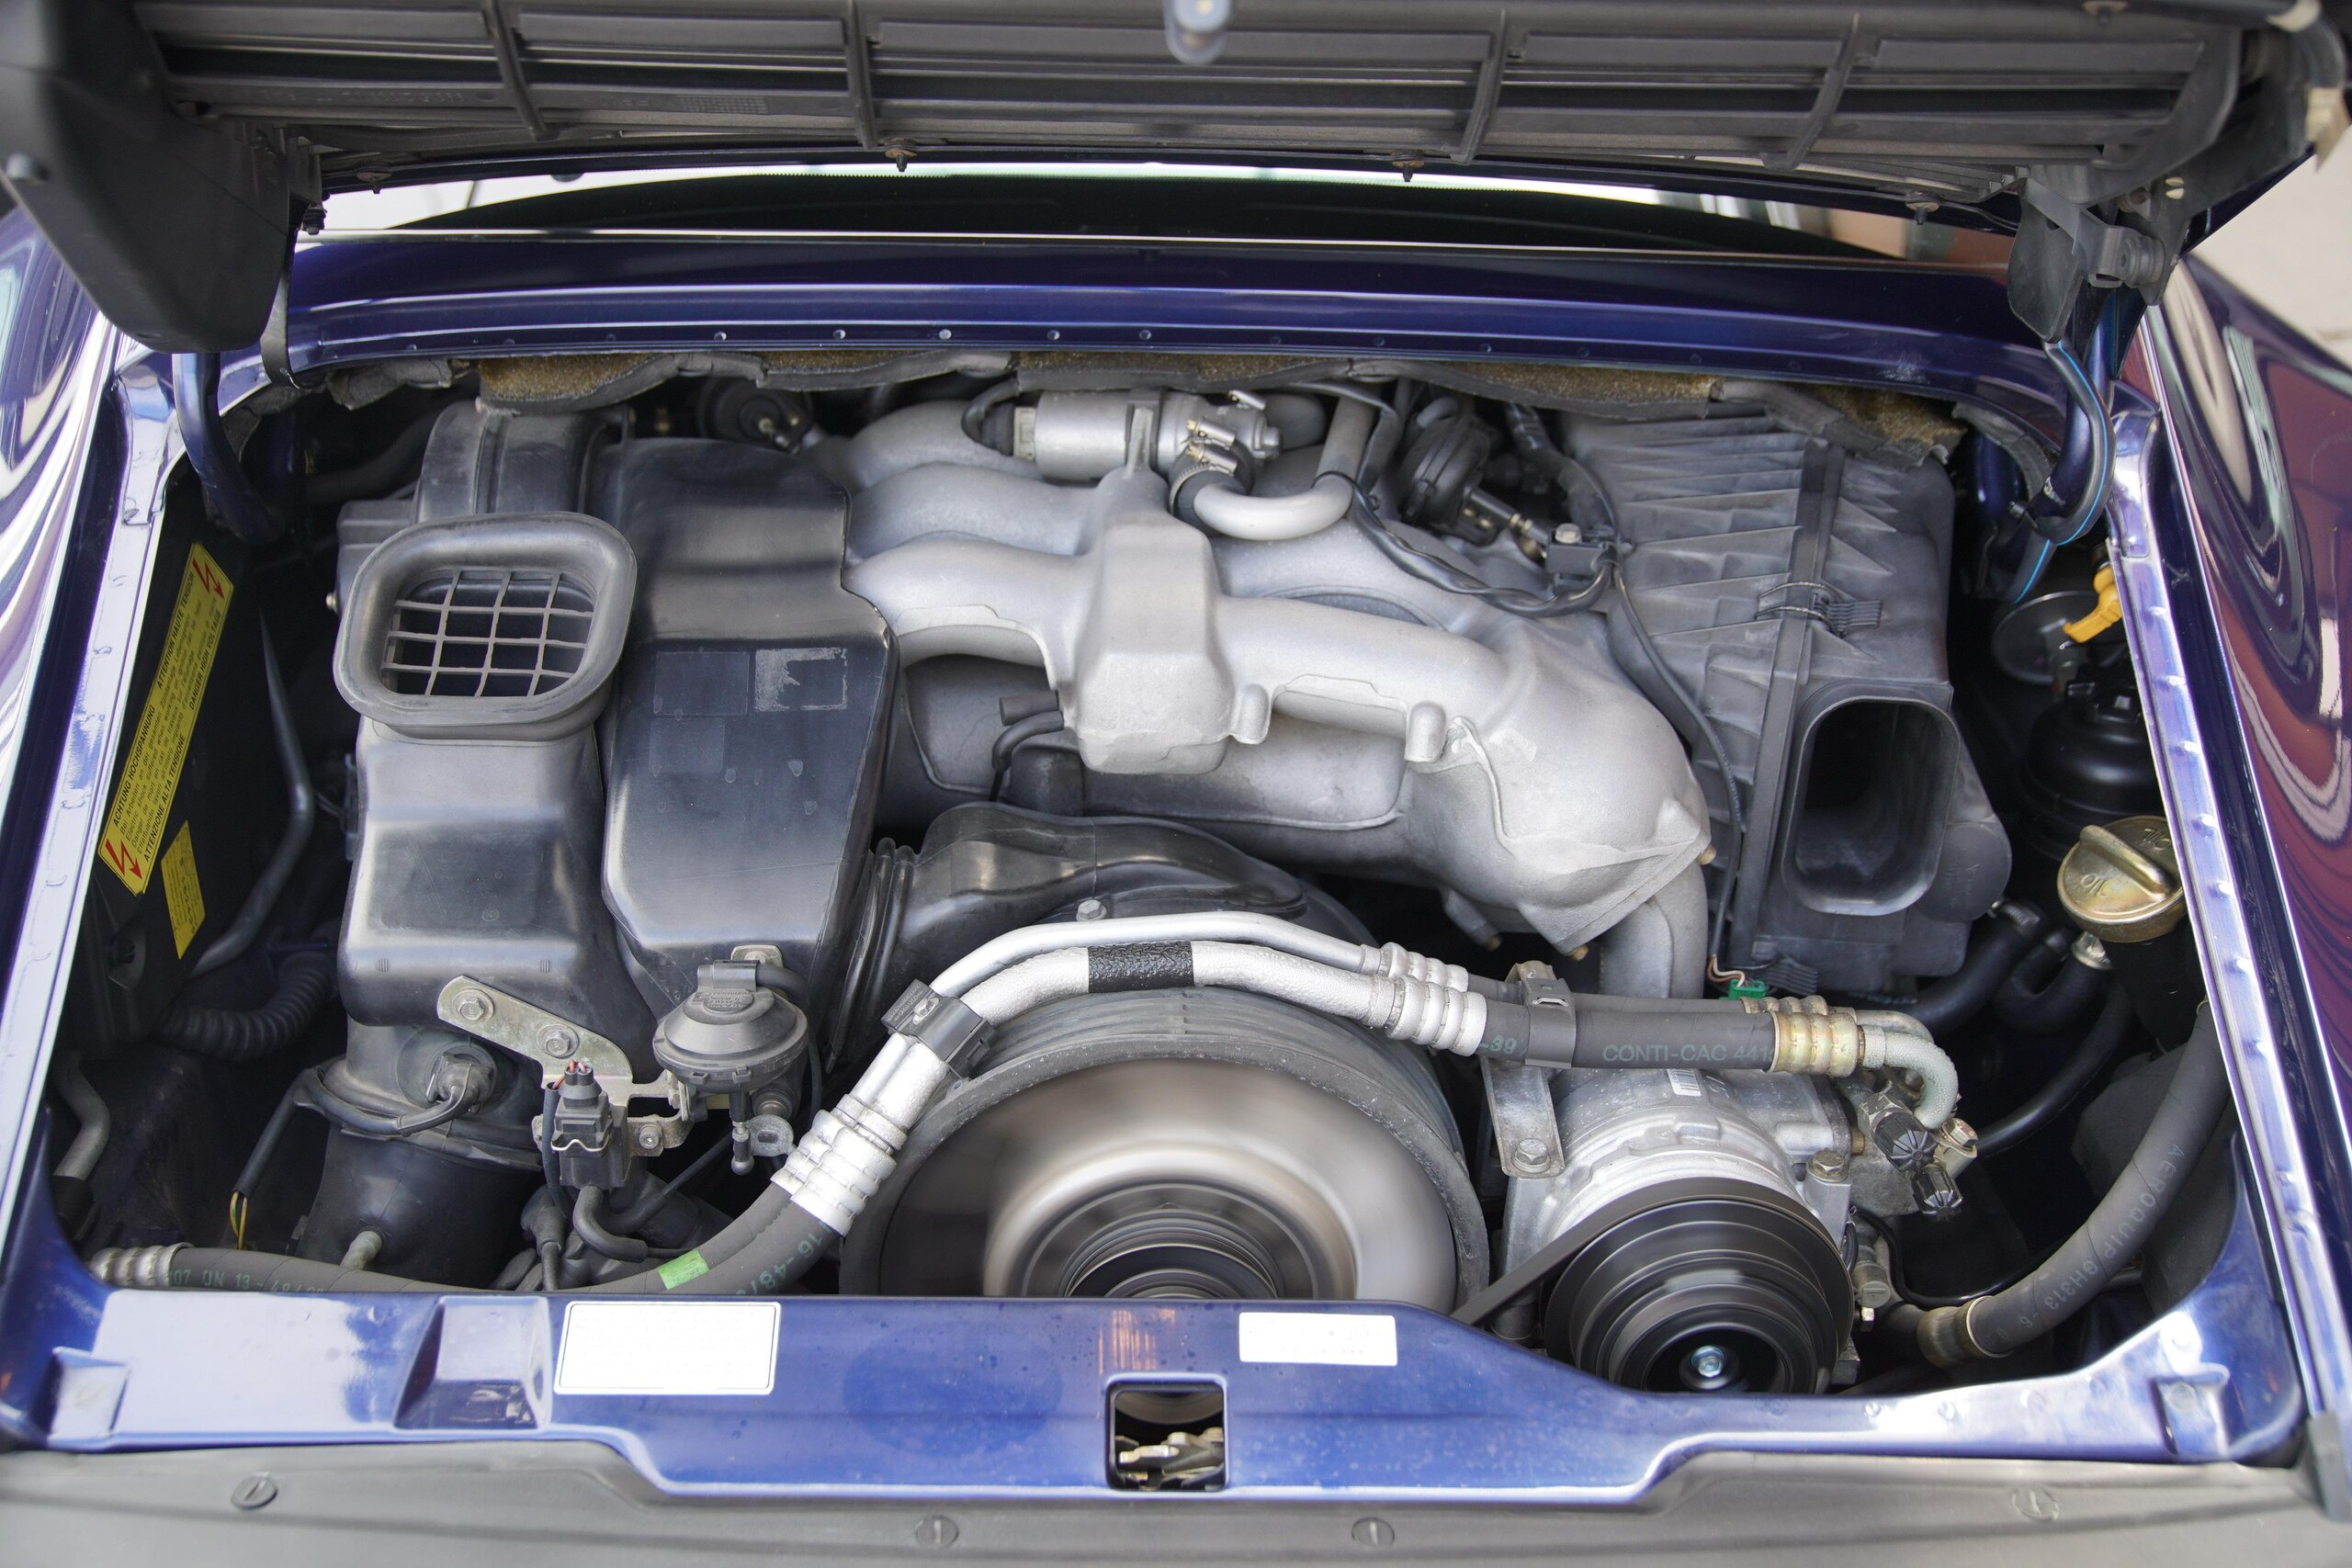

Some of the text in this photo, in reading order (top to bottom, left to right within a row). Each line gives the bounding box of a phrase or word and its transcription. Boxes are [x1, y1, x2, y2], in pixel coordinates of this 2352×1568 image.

[155, 571, 196, 689] ATTENTION HAUTE TENSION
[188, 609, 222, 711] DANGER HIGH VOLTAGE
[113, 703, 154, 828] ACHTUNG HOCHSPANNUNG
[119, 818, 128, 836] Bei
[125, 781, 140, 818] Arbeiten
[136, 766, 144, 781] an
[141, 750, 149, 766] der
[125, 808, 139, 842] Electric
[135, 781, 147, 808] shock
[154, 722, 165, 746] when
[162, 690, 175, 722] working
[142, 732, 186, 863] ATTENZIONE ALTA TENSIONE
[130, 816, 144, 849] Danger
[1601, 1043, 1728, 1064] CONTI-CAC
[2102, 1142, 2185, 1259] AEROQUIP
[201, 1269, 226, 1287] DN
[234, 1272, 252, 1290] 13
